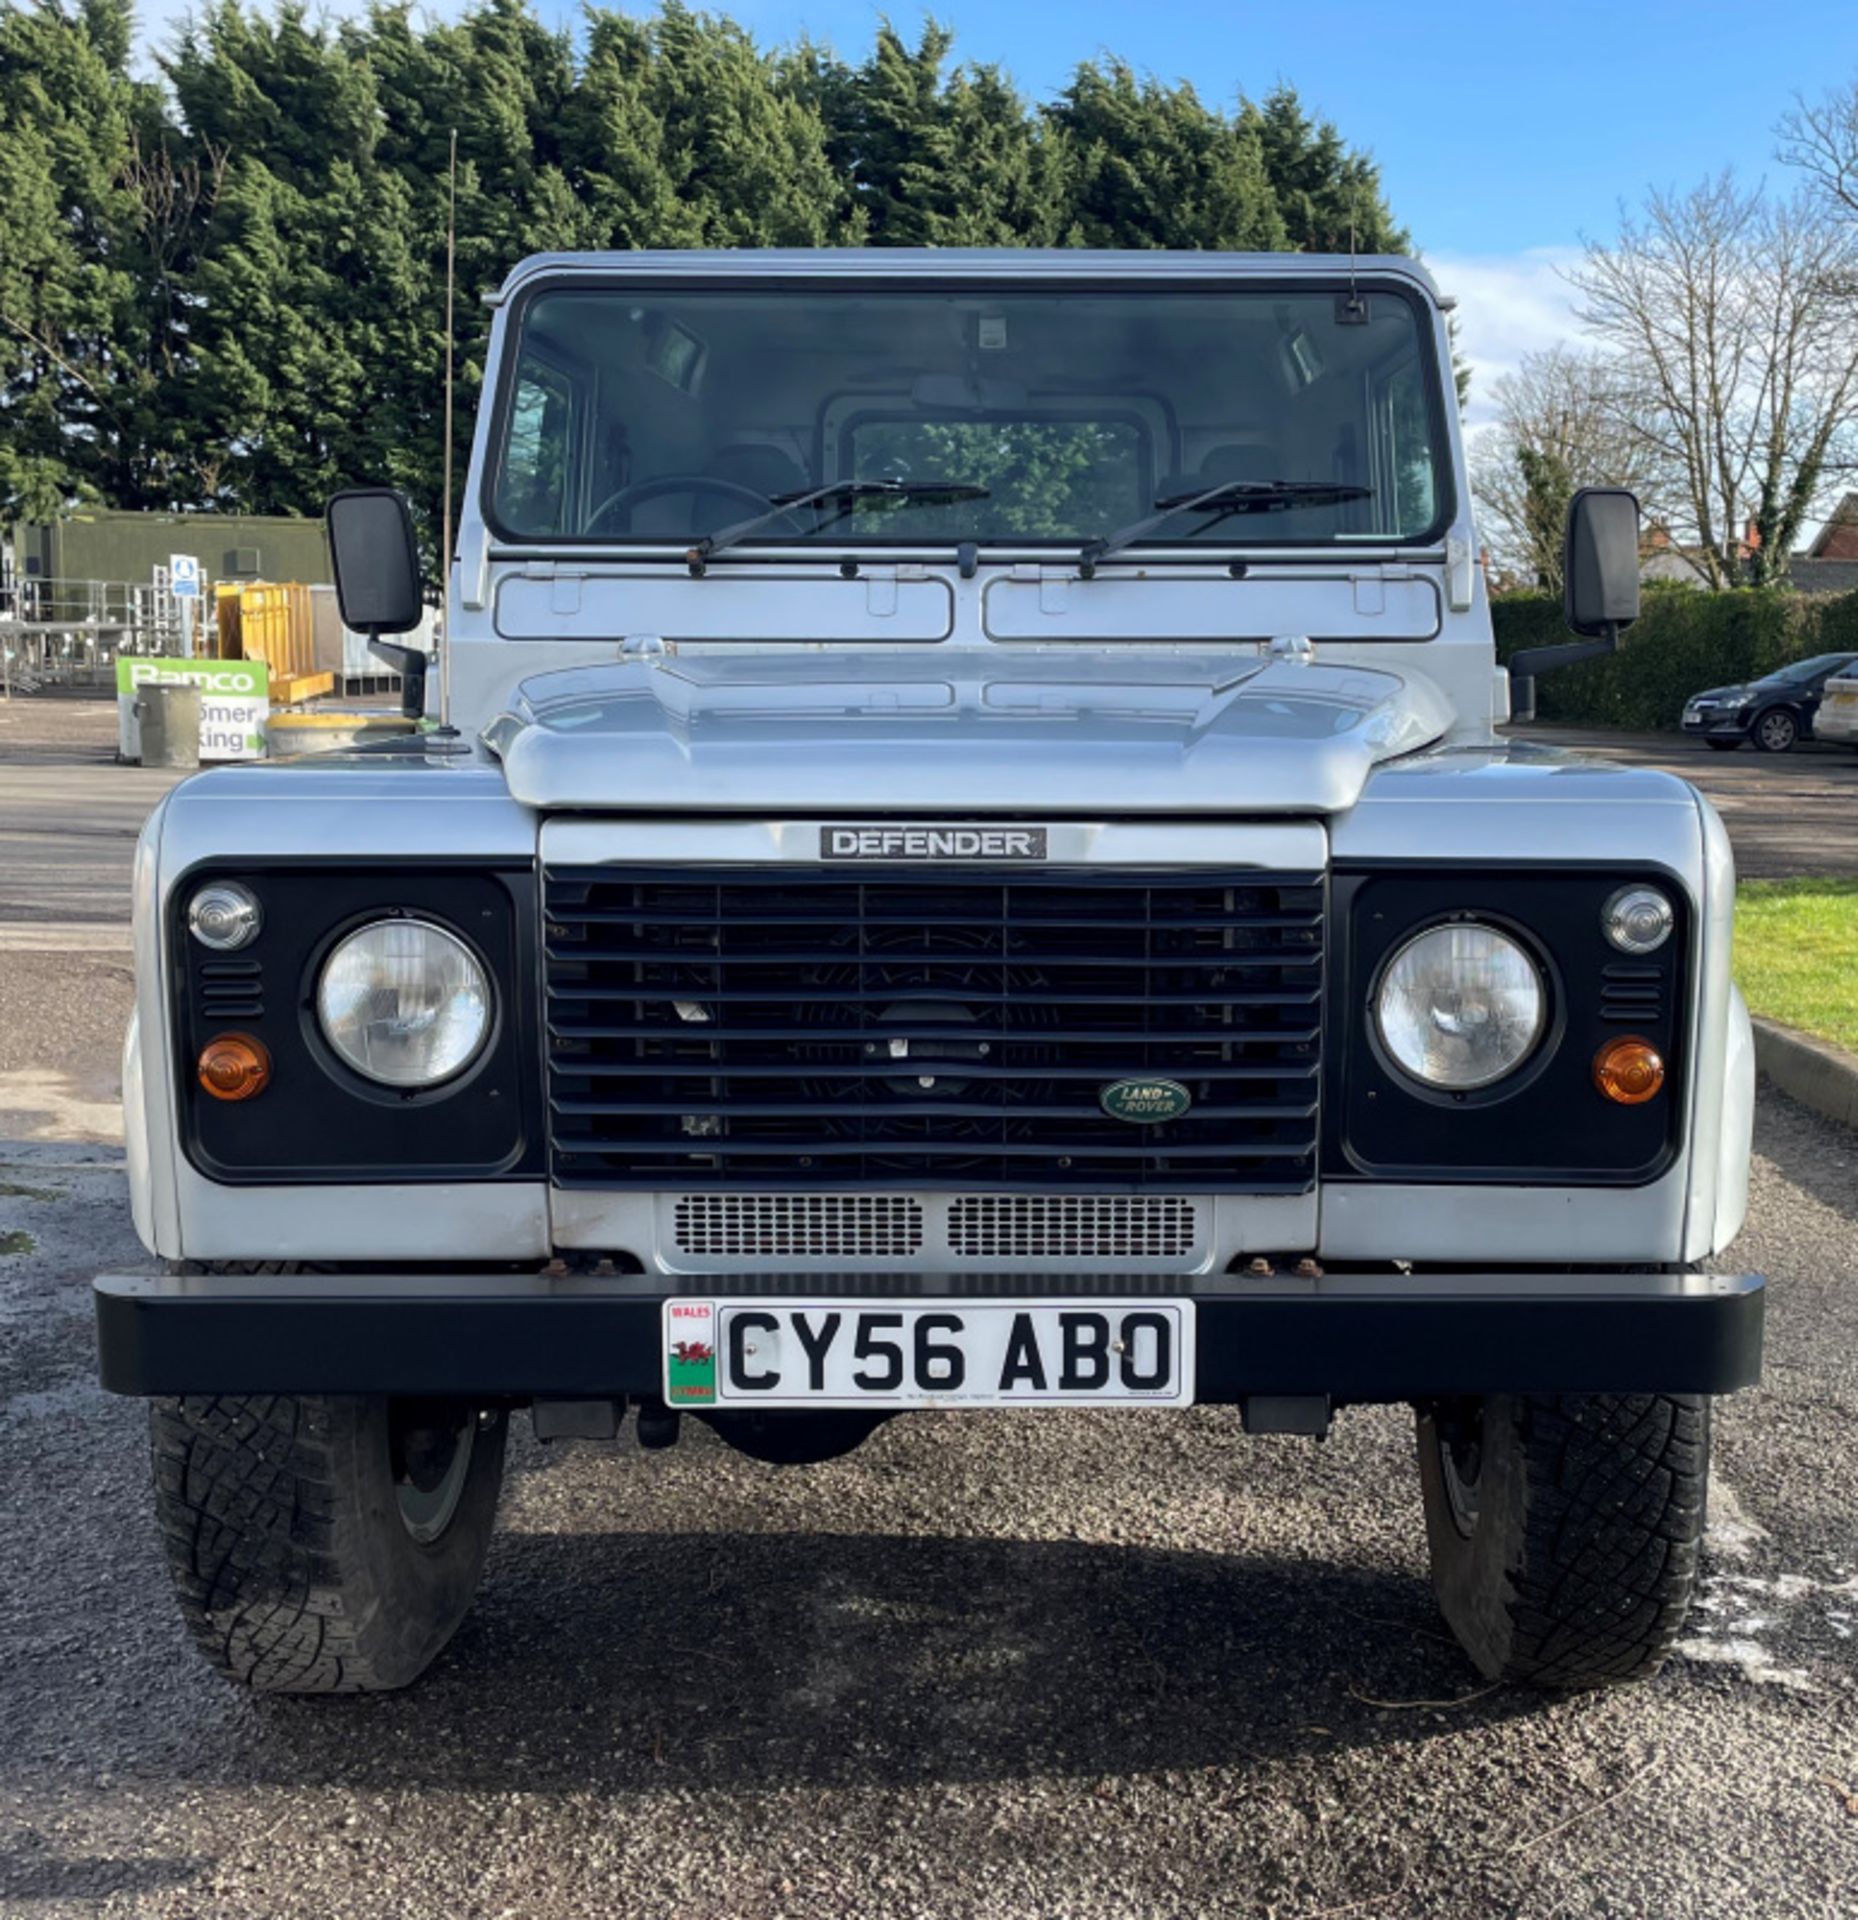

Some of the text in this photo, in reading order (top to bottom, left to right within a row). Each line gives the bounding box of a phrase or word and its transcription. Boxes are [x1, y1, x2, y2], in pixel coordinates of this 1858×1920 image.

[130, 664, 255, 691] Ramco
[832, 830, 1031, 855] DEFENDER
[1124, 1101, 1175, 1112] ROVER
[671, 1306, 711, 1318] WALES
[729, 1312, 1171, 1390] CY56 ABO
